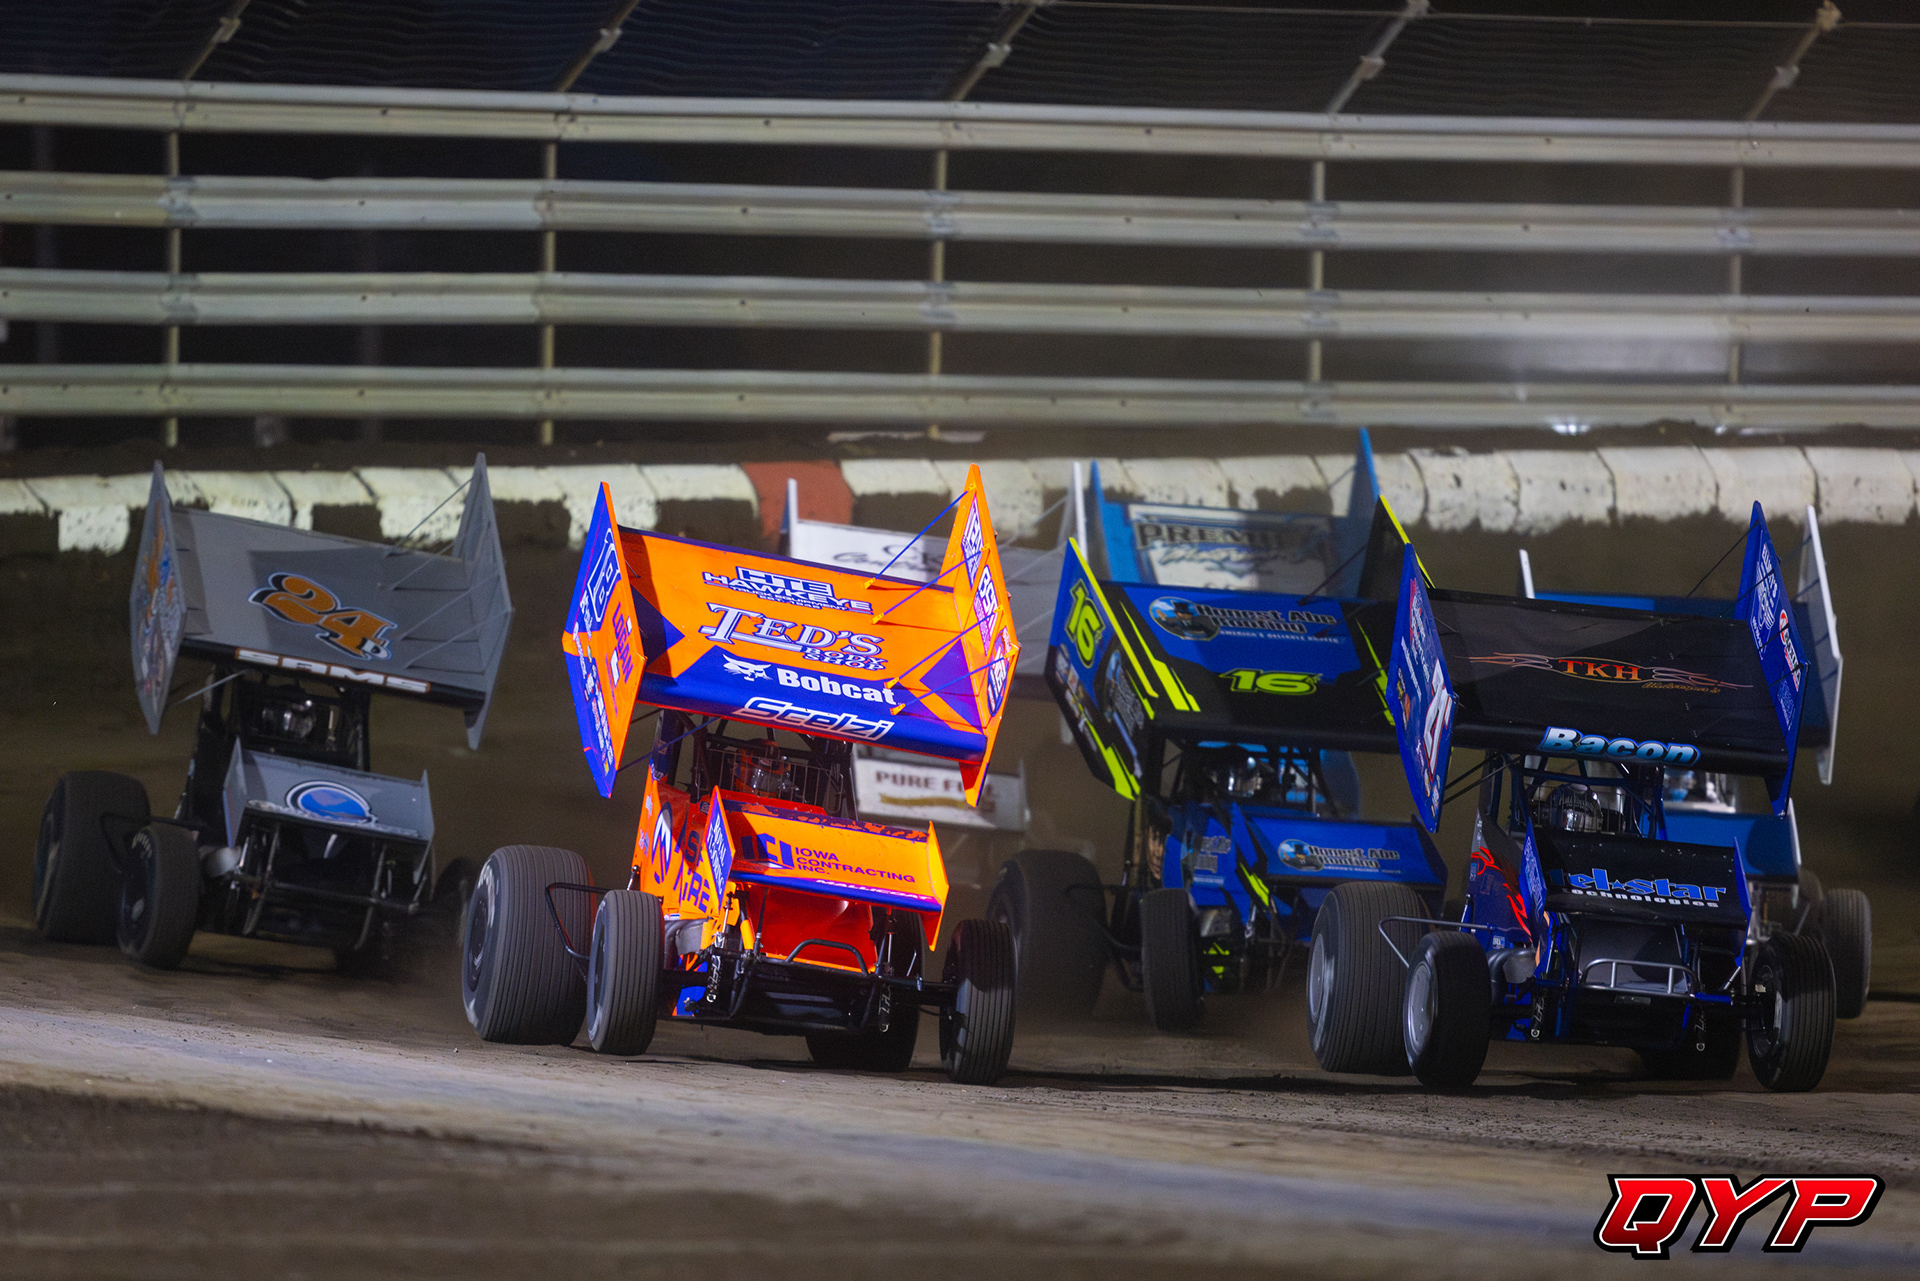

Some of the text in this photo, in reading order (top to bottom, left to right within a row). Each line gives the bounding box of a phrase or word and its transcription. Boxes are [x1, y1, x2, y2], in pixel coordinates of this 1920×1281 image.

[702, 572, 873, 612] HAWKEYE
[735, 566, 835, 598] HTE
[706, 602, 885, 657] TED'S
[1065, 579, 1106, 668] 16
[612, 601, 634, 685] LOGAN
[802, 646, 888, 666] BODY
[235, 648, 430, 693] SAMS
[803, 654, 887, 671] SHOP
[1558, 659, 1641, 681] TKH
[777, 668, 896, 705] Bobcat
[1216, 667, 1322, 696] 16
[732, 696, 895, 741] Scelzi
[1537, 725, 1701, 766] Bacon
[876, 771, 935, 789] PURE
[795, 846, 839, 862] IOWA
[798, 863, 831, 875] INC.
[796, 857, 916, 883] CONTRACTING
[1562, 888, 1719, 908] technologies
